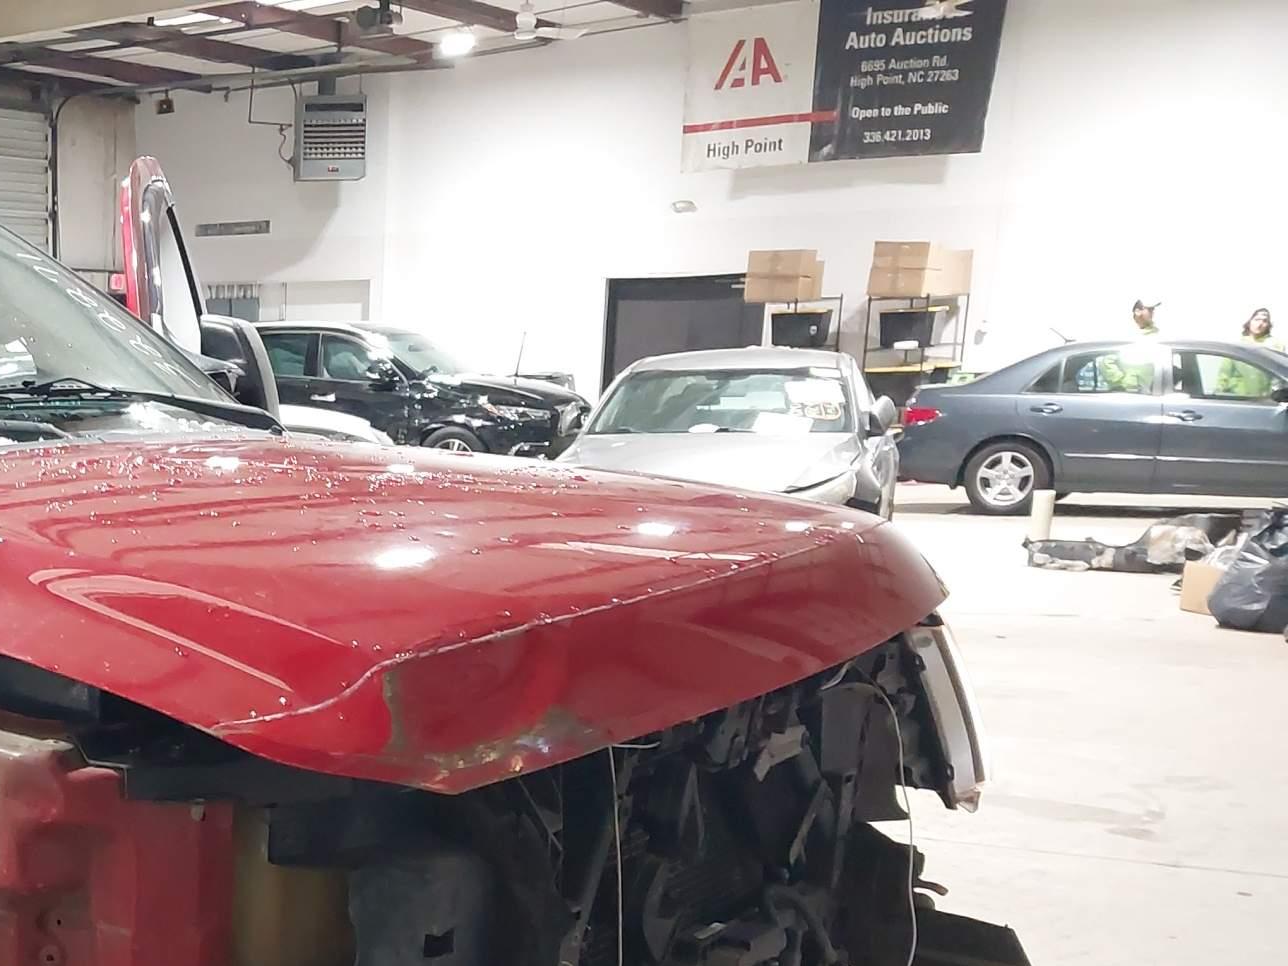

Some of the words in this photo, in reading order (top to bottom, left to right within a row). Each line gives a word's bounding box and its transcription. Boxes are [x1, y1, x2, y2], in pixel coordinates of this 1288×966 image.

[866, 6, 955, 25] Insura
[845, 31, 887, 50] Auto
[892, 25, 973, 46] Auctions
[888, 58, 930, 70] Auction
[850, 75, 874, 89] High
[907, 71, 925, 84] NC
[927, 69, 960, 82] 27263
[852, 107, 879, 120] Open
[881, 107, 891, 117] to
[894, 104, 912, 116] the
[914, 102, 949, 115] Public
[863, 128, 931, 144] 336.421.2013
[707, 141, 740, 160] High
[745, 137, 783, 155] Point
